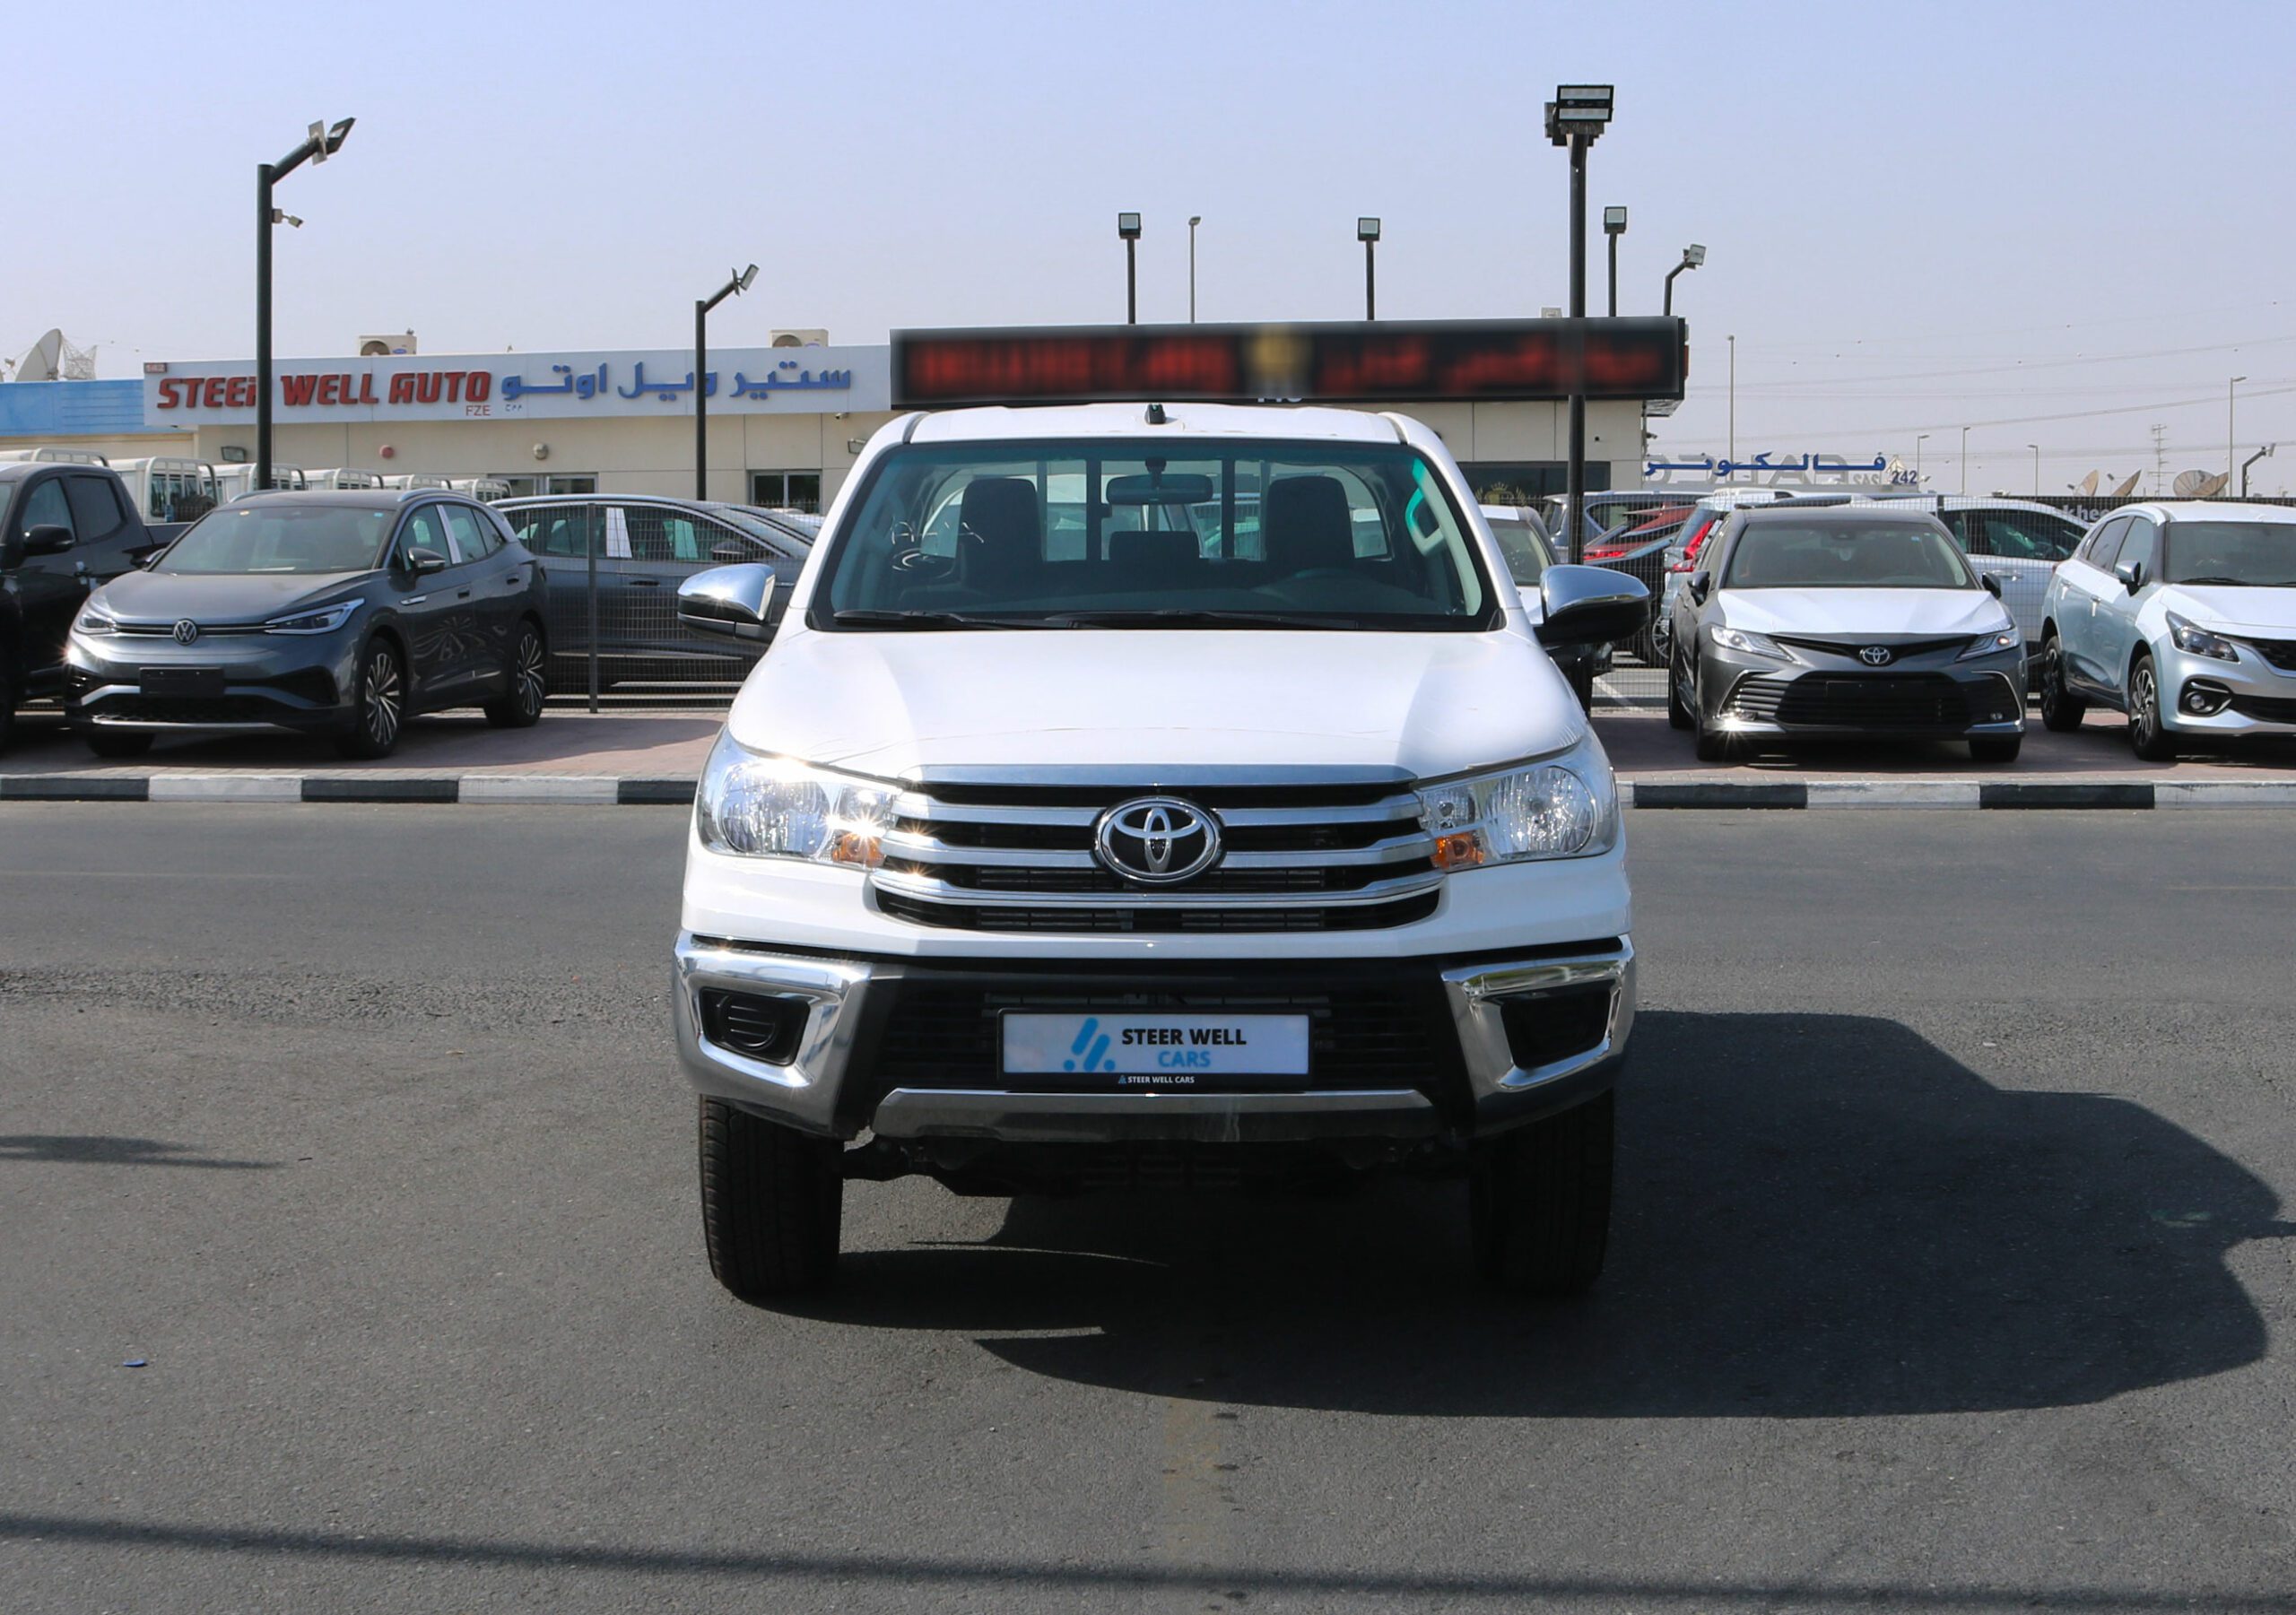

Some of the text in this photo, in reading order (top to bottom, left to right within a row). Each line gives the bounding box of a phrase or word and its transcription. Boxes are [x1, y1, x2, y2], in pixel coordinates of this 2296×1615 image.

[280, 373, 379, 406] WELL
[388, 370, 492, 404] AUTO
[728, 360, 851, 400] ستير
[465, 405, 491, 417] FZE
[1892, 470, 1918, 484] 242
[1121, 1029, 1248, 1046] STEER WELL
[1158, 1051, 1211, 1069] CARS
[1127, 1076, 1196, 1084] STEER WELL CARS
